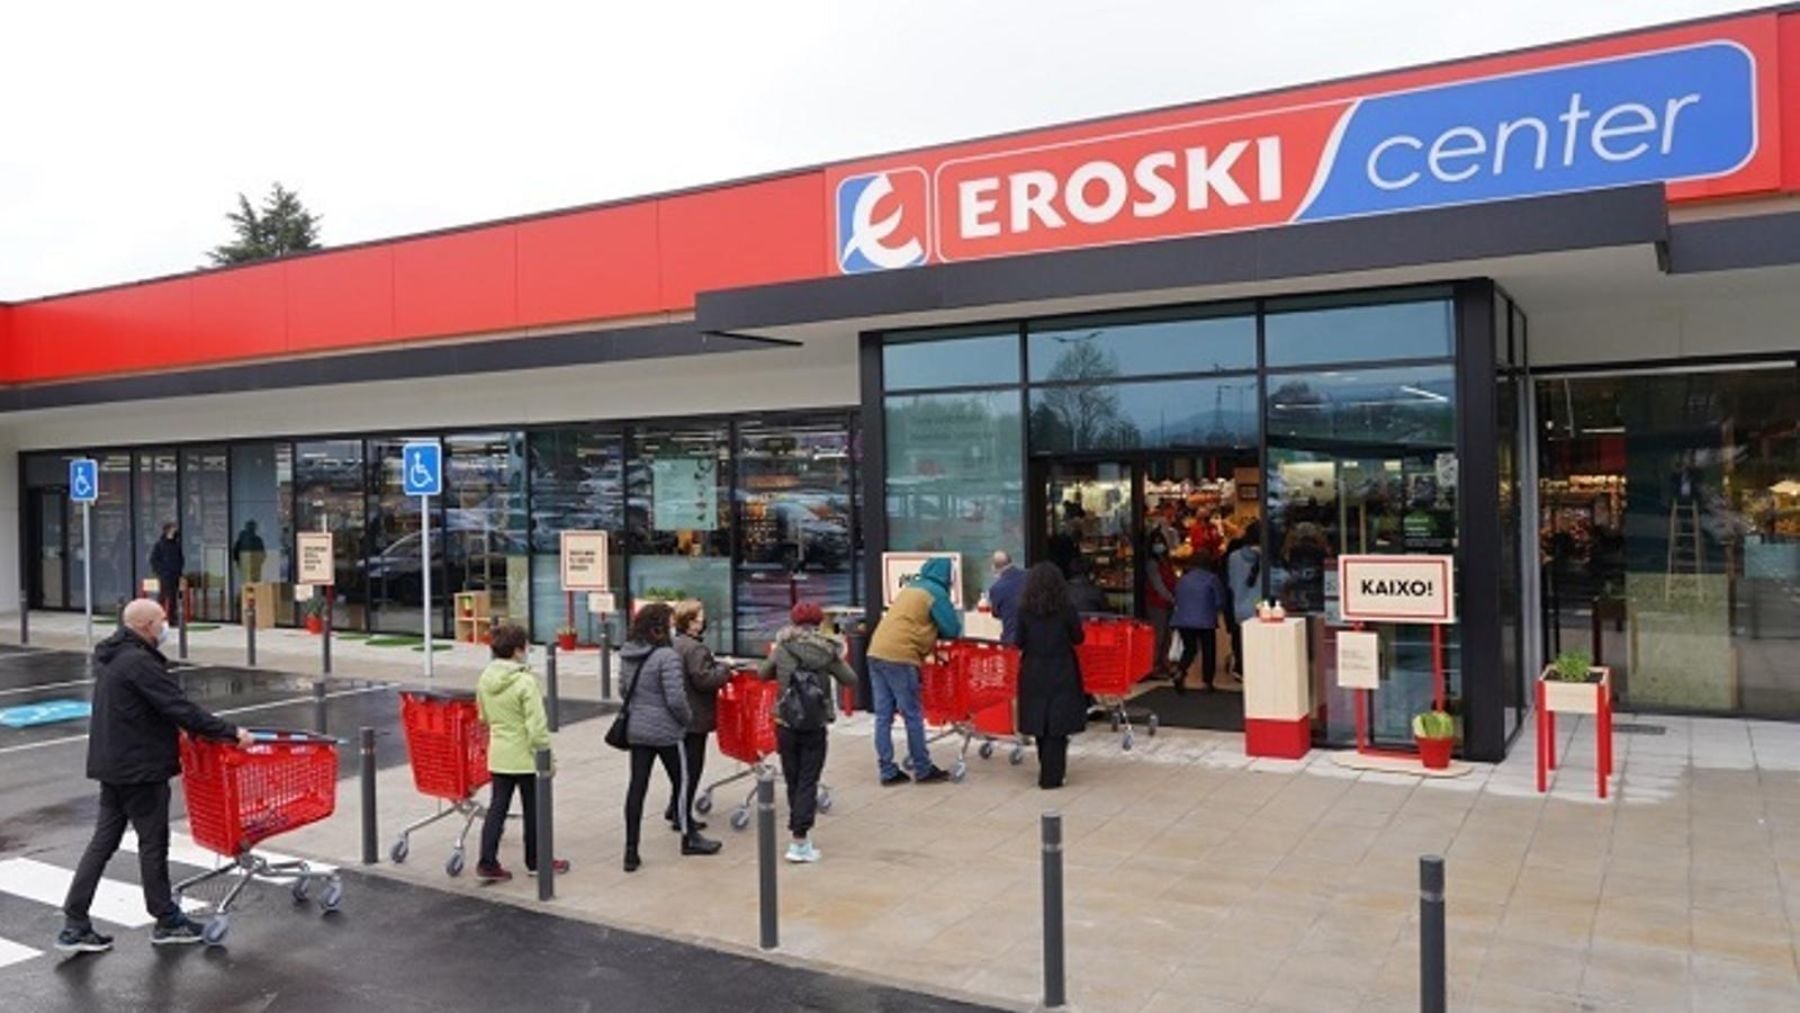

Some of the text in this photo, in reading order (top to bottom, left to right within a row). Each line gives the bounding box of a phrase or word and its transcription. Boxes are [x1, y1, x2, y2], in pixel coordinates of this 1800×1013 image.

[958, 135, 1281, 239] EROSKI
[1367, 94, 1699, 189] center
[1361, 579, 1434, 597] KAIXO!
